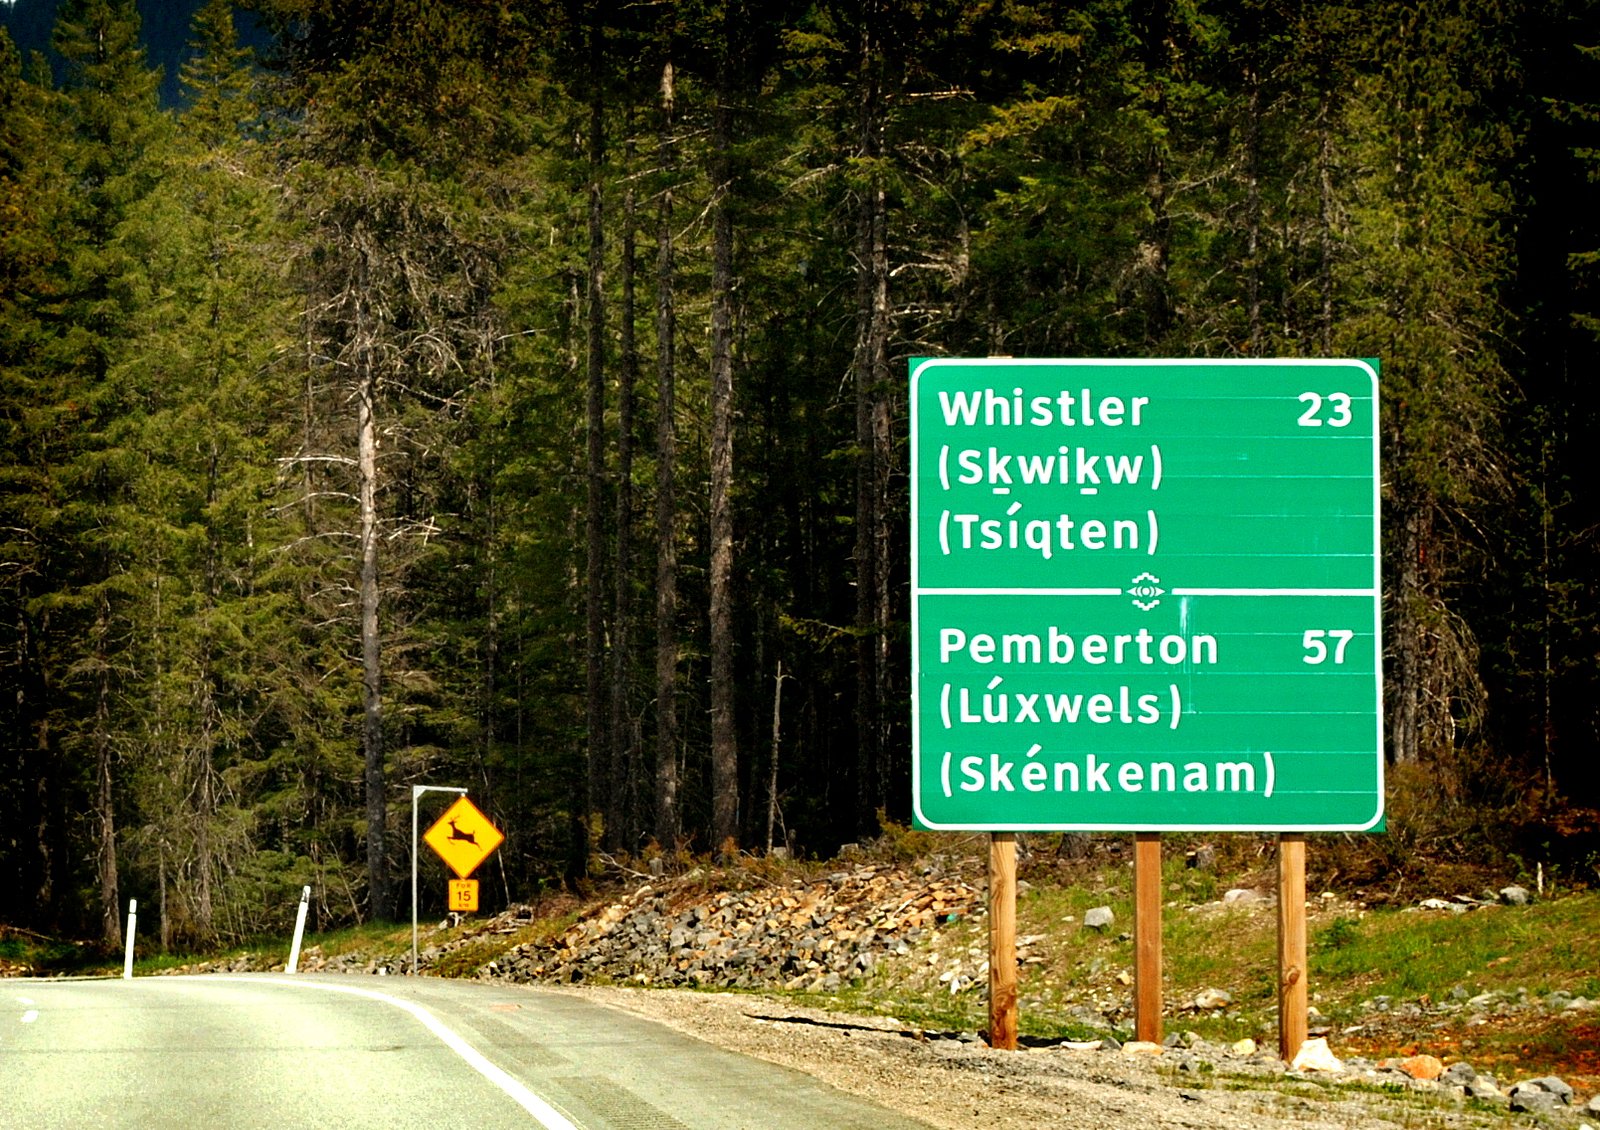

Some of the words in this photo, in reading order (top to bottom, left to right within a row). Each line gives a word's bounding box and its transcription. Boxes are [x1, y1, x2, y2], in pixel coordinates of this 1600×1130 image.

[938, 387, 1149, 427] Whistler
[1297, 391, 1353, 428] 23
[939, 501, 1159, 560] (Tsíqten)
[940, 626, 1218, 665] Pemberton
[1302, 629, 1354, 665] 57
[940, 675, 1182, 730] (Lúxwels)
[941, 743, 1276, 798] (Skénkenam)
[456, 890, 471, 901] 15
